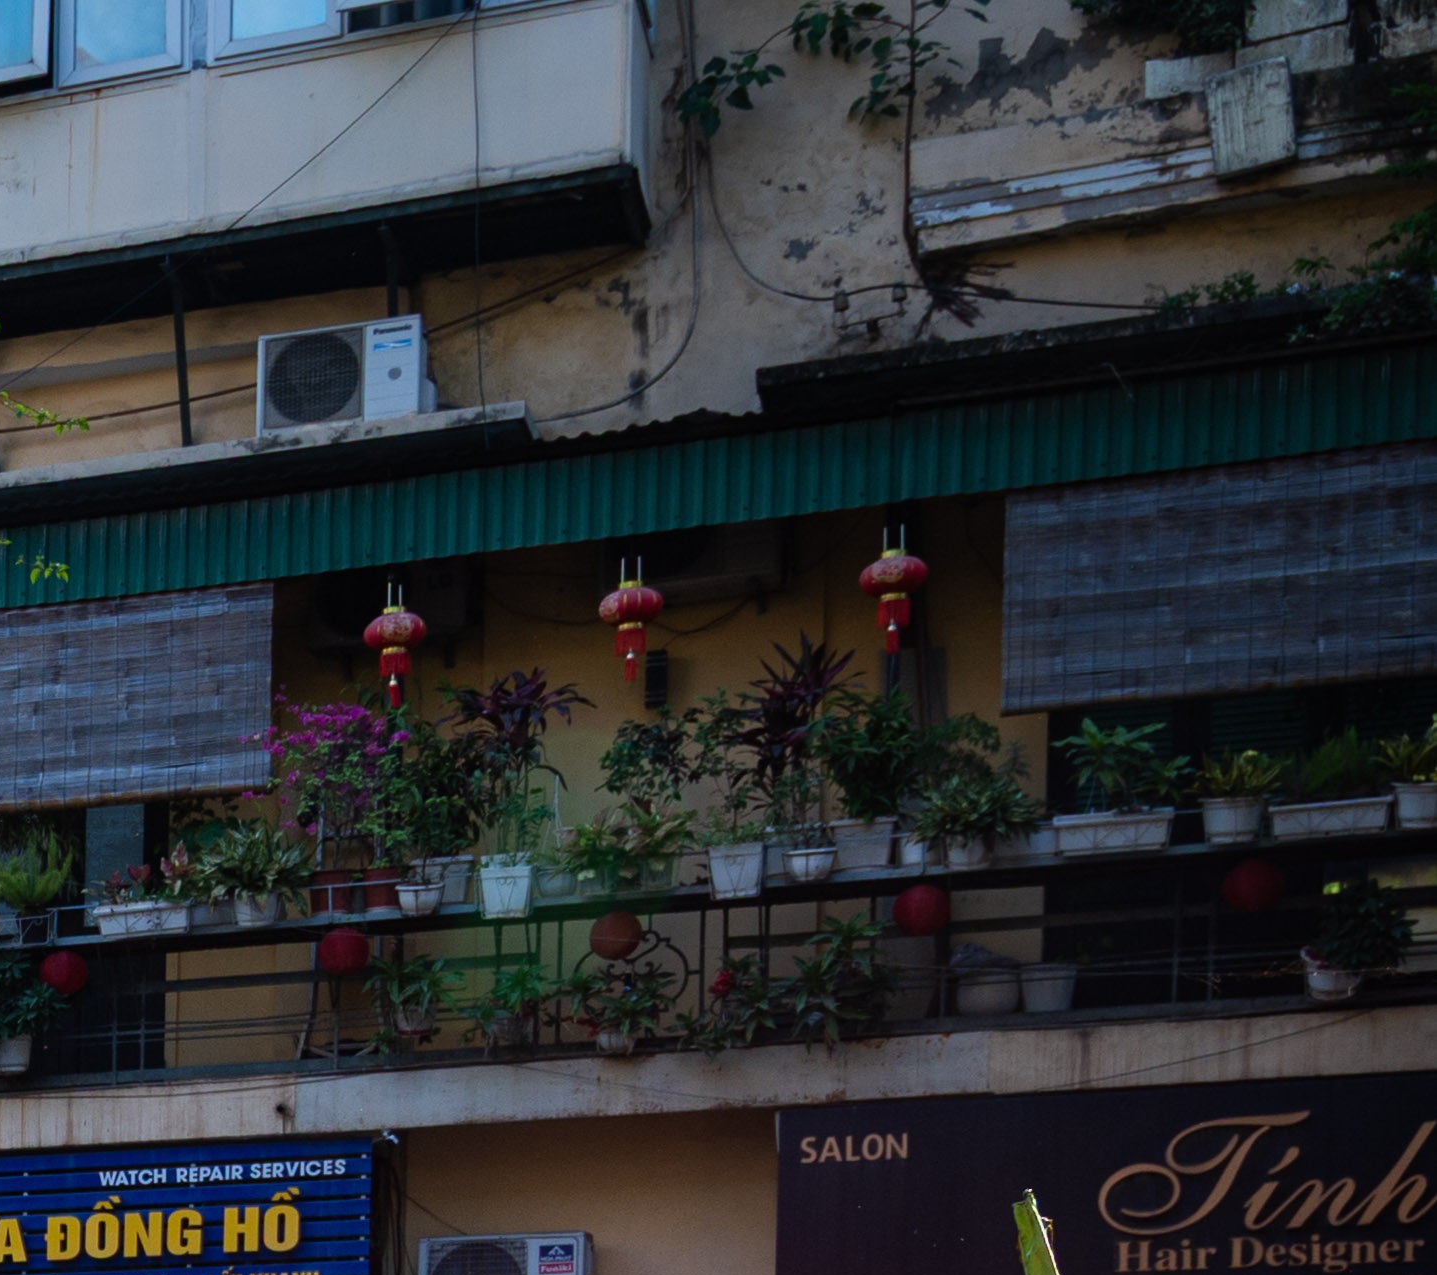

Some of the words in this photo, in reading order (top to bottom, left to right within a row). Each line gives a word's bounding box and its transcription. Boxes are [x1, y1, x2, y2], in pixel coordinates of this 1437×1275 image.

[799, 1132, 909, 1164] SALON
[99, 1169, 167, 1187] WATCH
[176, 1165, 243, 1184] REPAIR
[250, 1159, 346, 1181] SERVICES
[44, 1195, 203, 1261] ĐỒNG
[223, 1186, 301, 1253] HỒ
[1115, 1238, 1217, 1273] Hair
[1229, 1234, 1425, 1273] Designer
